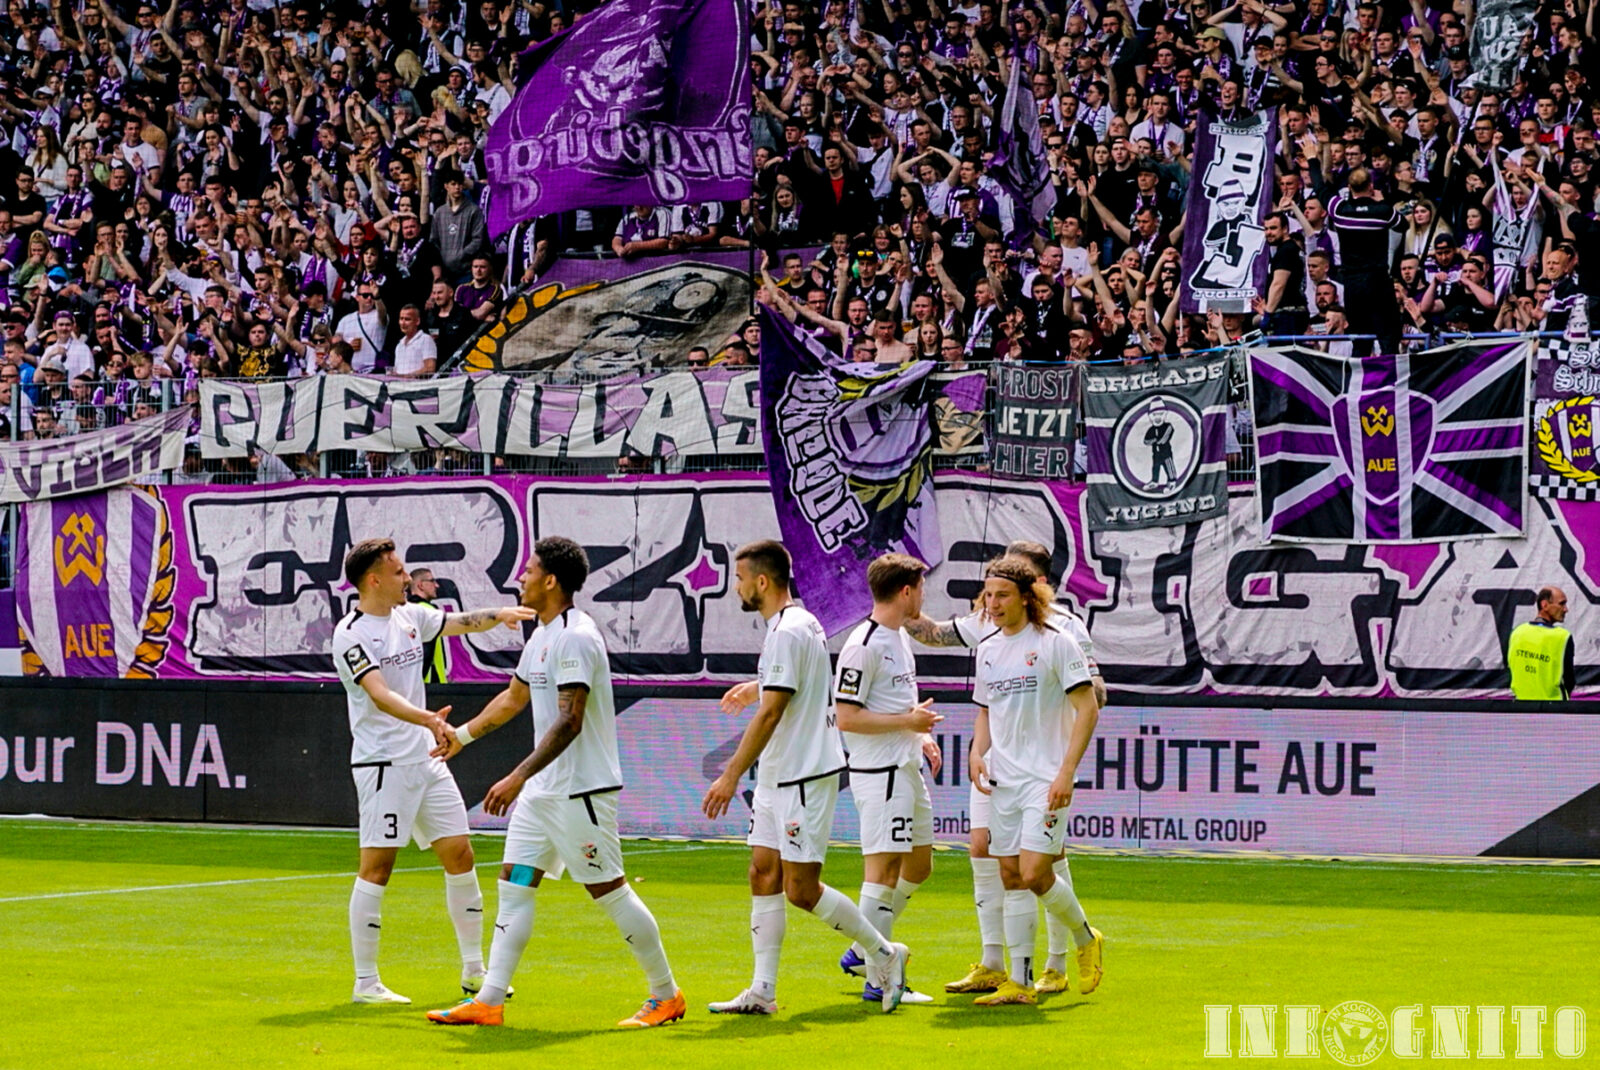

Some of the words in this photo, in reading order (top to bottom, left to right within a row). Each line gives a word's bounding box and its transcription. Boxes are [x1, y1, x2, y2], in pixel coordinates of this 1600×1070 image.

[1193, 289, 1257, 299] JUGEND
[999, 367, 1073, 400] PROST
[1087, 362, 1226, 392] BRIGADE
[200, 371, 762, 460] GUERILLAS
[998, 408, 1072, 437] JETZT
[994, 443, 1069, 477] HIER
[1367, 458, 1396, 472] AUE
[1572, 447, 1591, 457] AUE
[1105, 496, 1216, 521] JUGEND
[65, 624, 115, 659] AUE
[1516, 649, 1551, 663] STEWARD
[0, 736, 74, 783] ur
[96, 721, 247, 789] DNA.
[1277, 741, 1377, 797] AUE
[384, 813, 398, 839] 3
[1121, 817, 1189, 841] METAL
[1195, 818, 1267, 843] GROUP
